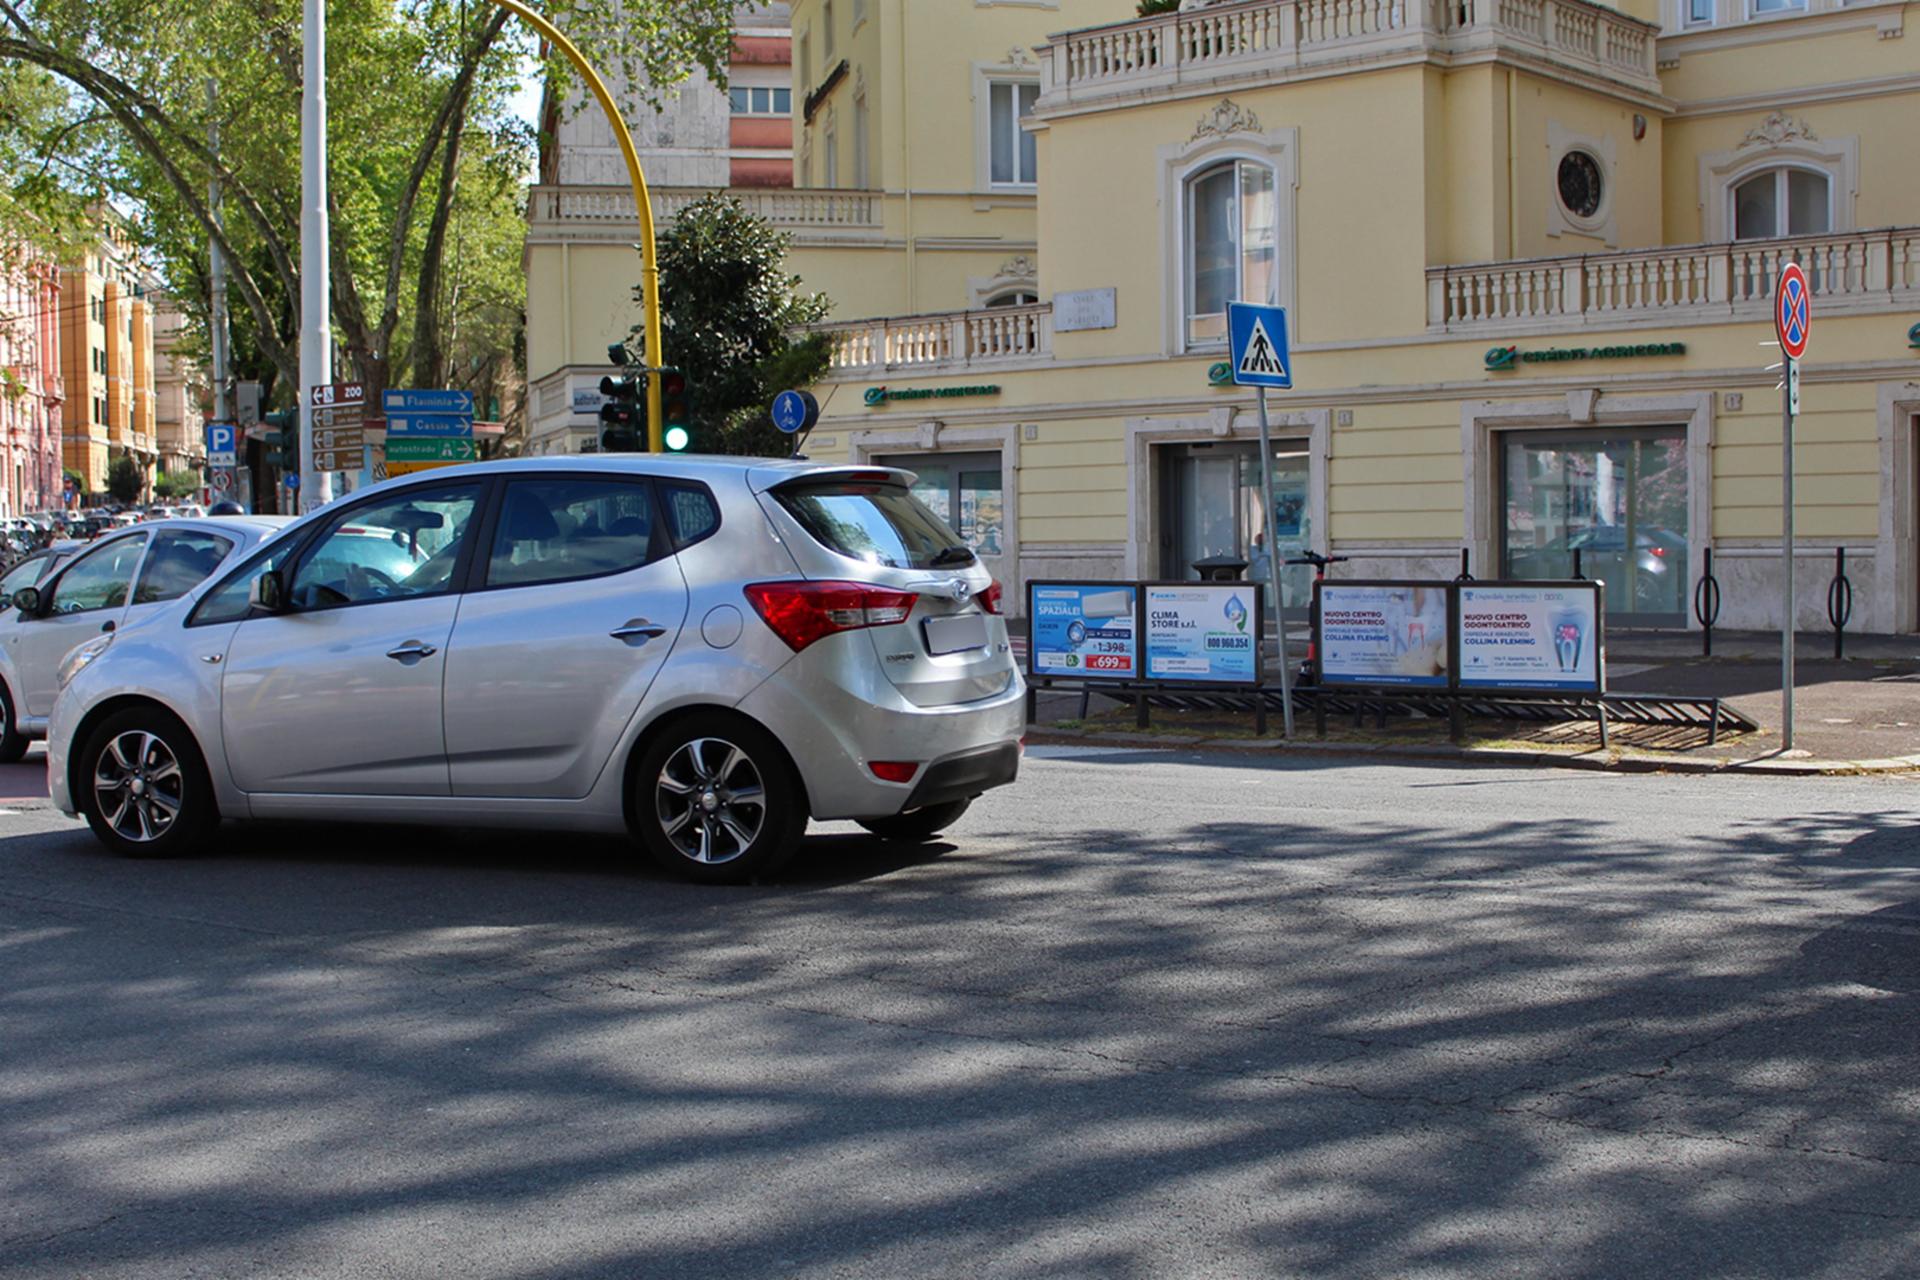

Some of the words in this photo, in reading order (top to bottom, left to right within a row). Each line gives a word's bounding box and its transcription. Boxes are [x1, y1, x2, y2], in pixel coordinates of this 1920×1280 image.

[344, 386, 362, 398] ZOO
[407, 395, 453, 406] Flaminia
[415, 419, 450, 430] Cassia
[213, 429, 230, 451] P
[1151, 611, 1179, 619] CLIMA
[1151, 620, 1179, 628] STORE
